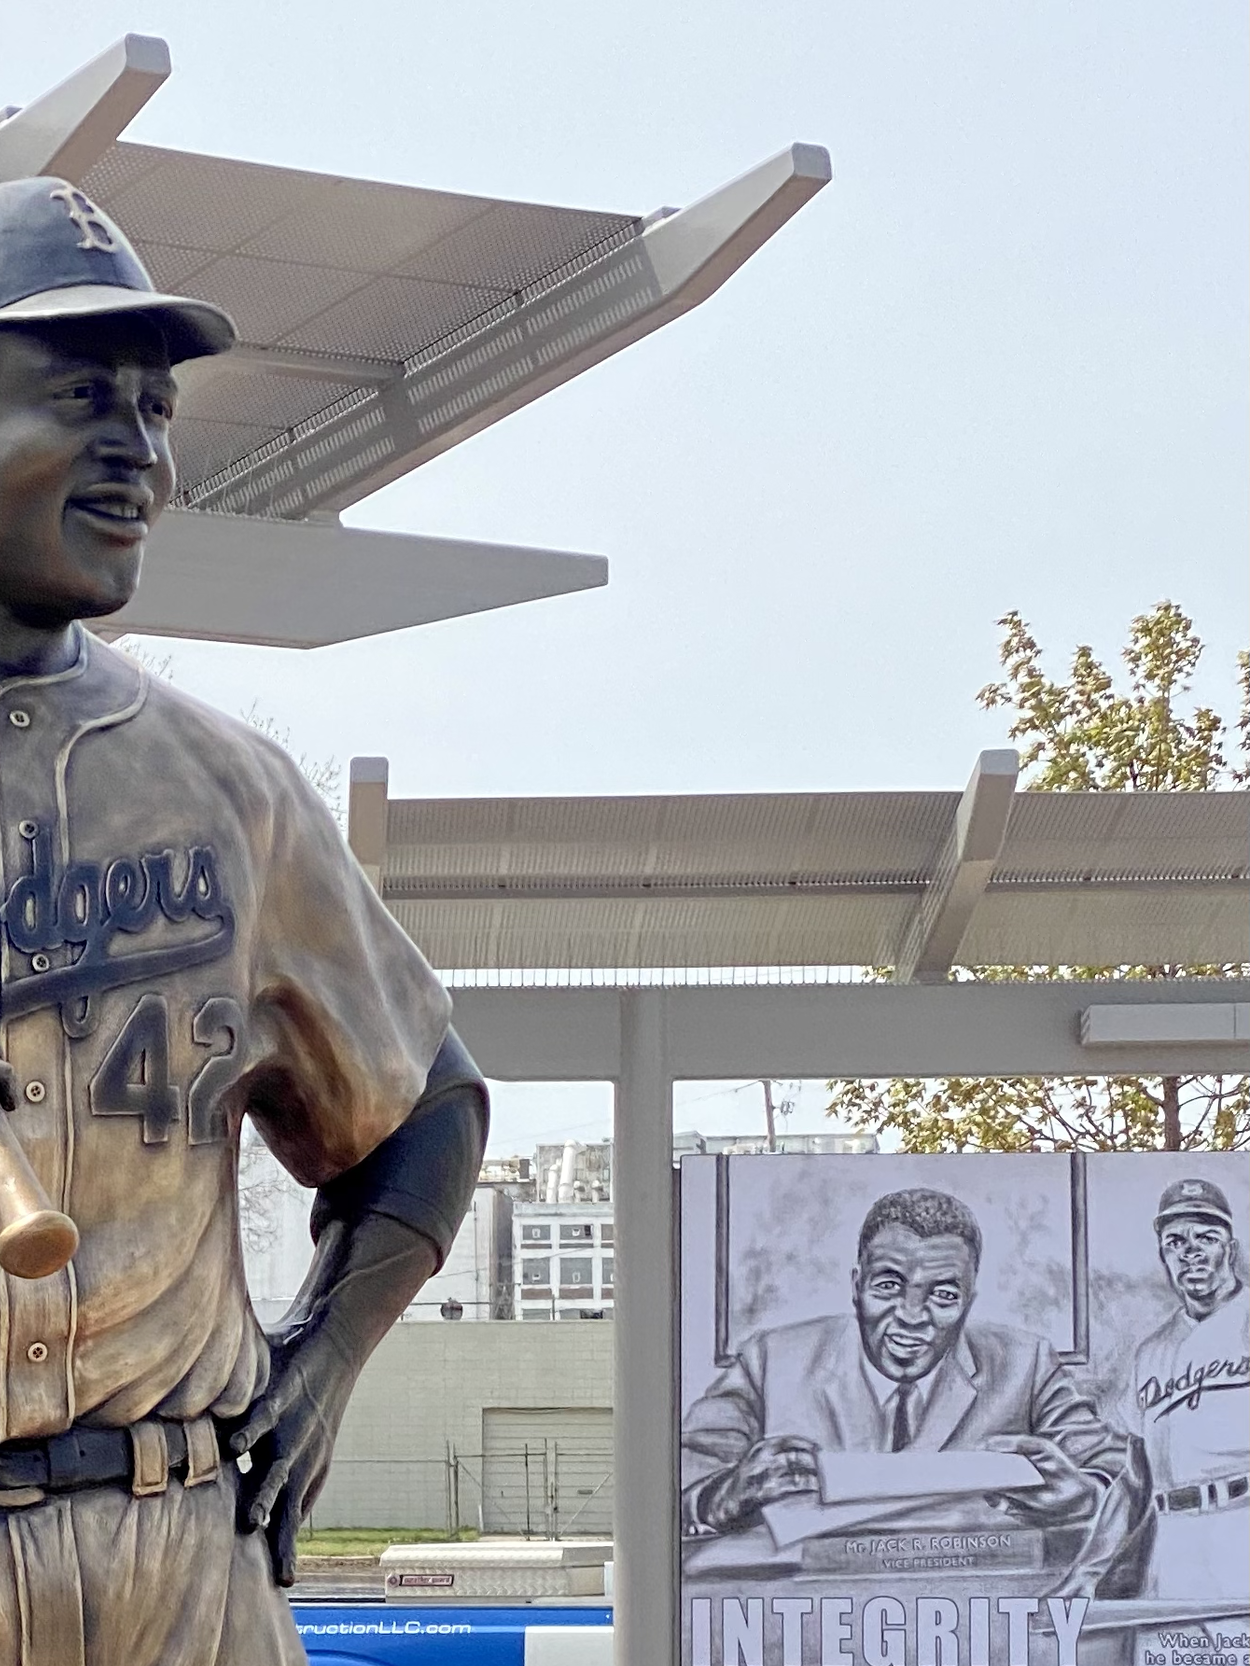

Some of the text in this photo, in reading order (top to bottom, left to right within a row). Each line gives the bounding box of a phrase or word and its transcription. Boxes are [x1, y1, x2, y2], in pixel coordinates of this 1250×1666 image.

[90, 993, 249, 1146] 42
[869, 1537, 907, 1554] JACK
[930, 1534, 1012, 1551] ROBINSON
[883, 1555, 975, 1569] VICE PRESIDENT
[1158, 1632, 1210, 1649] When
[1145, 1649, 1167, 1666] he
[1171, 1649, 1238, 1666] became
